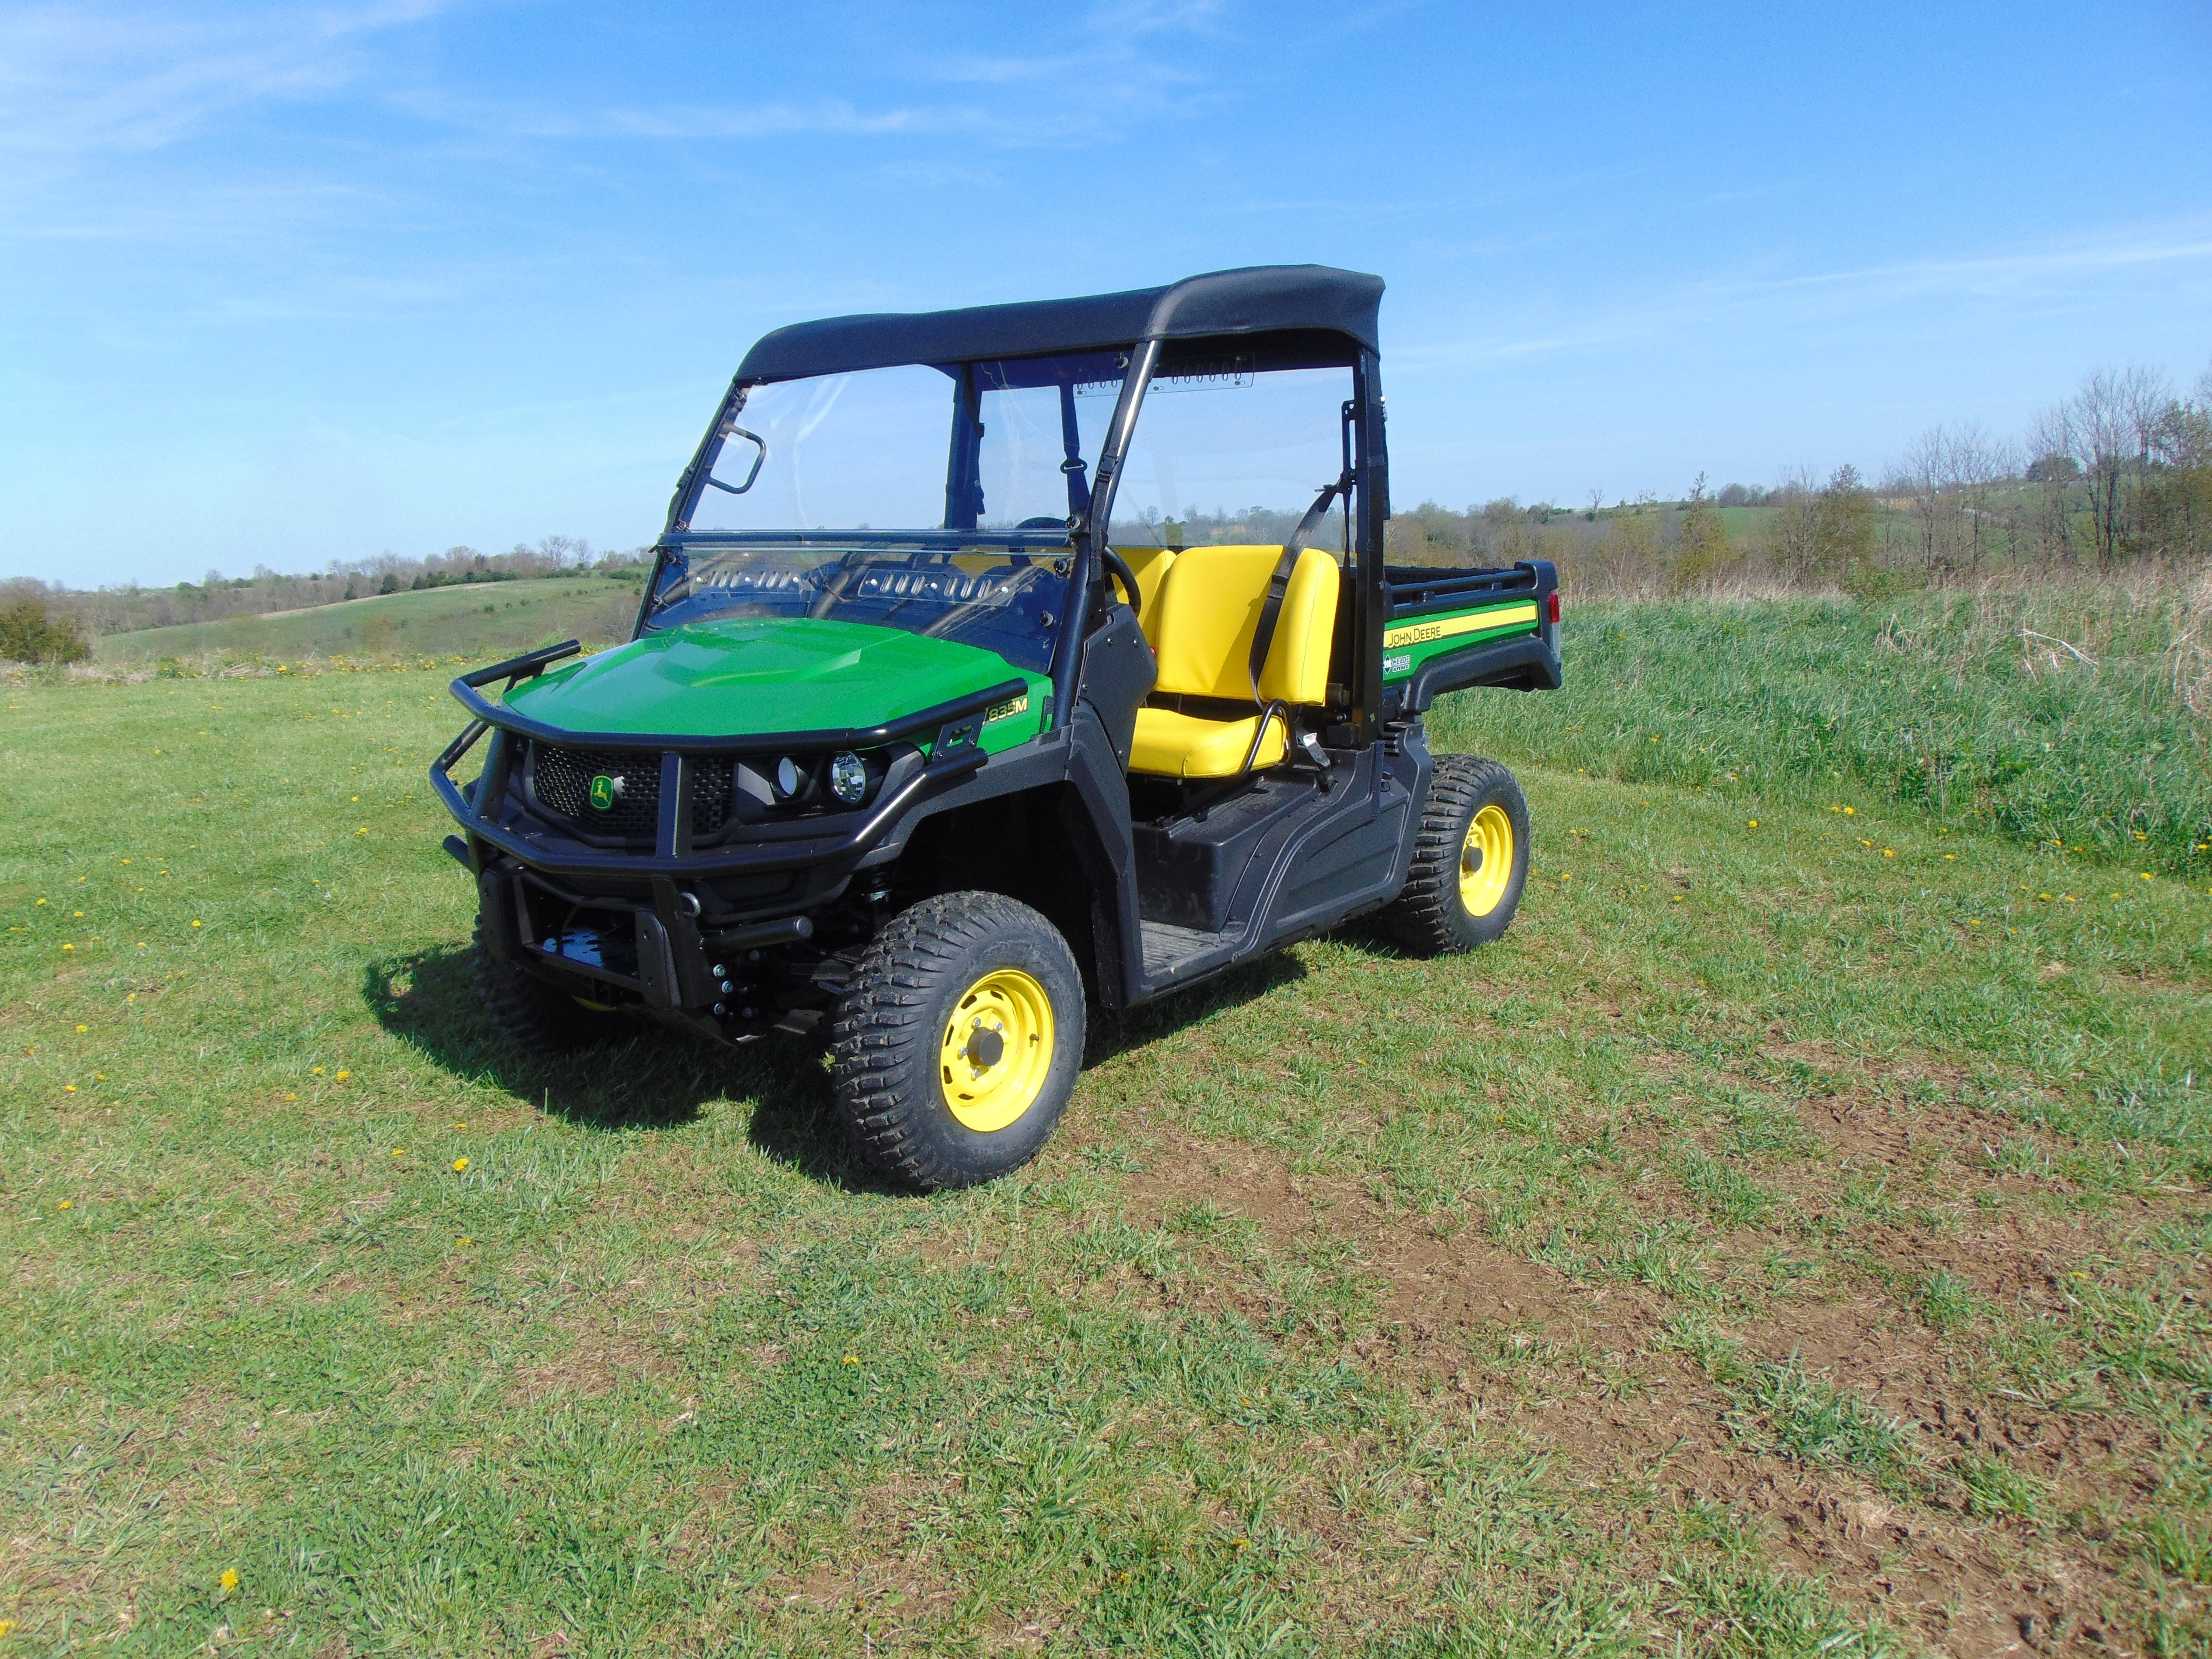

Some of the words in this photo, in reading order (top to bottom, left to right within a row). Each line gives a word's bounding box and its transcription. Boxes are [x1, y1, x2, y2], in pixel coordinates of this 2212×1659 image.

[1389, 632, 1412, 646] JOHN
[1414, 626, 1441, 641] DEERE
[1392, 655, 1410, 665] MEADE
[988, 698, 1027, 722] 835M
